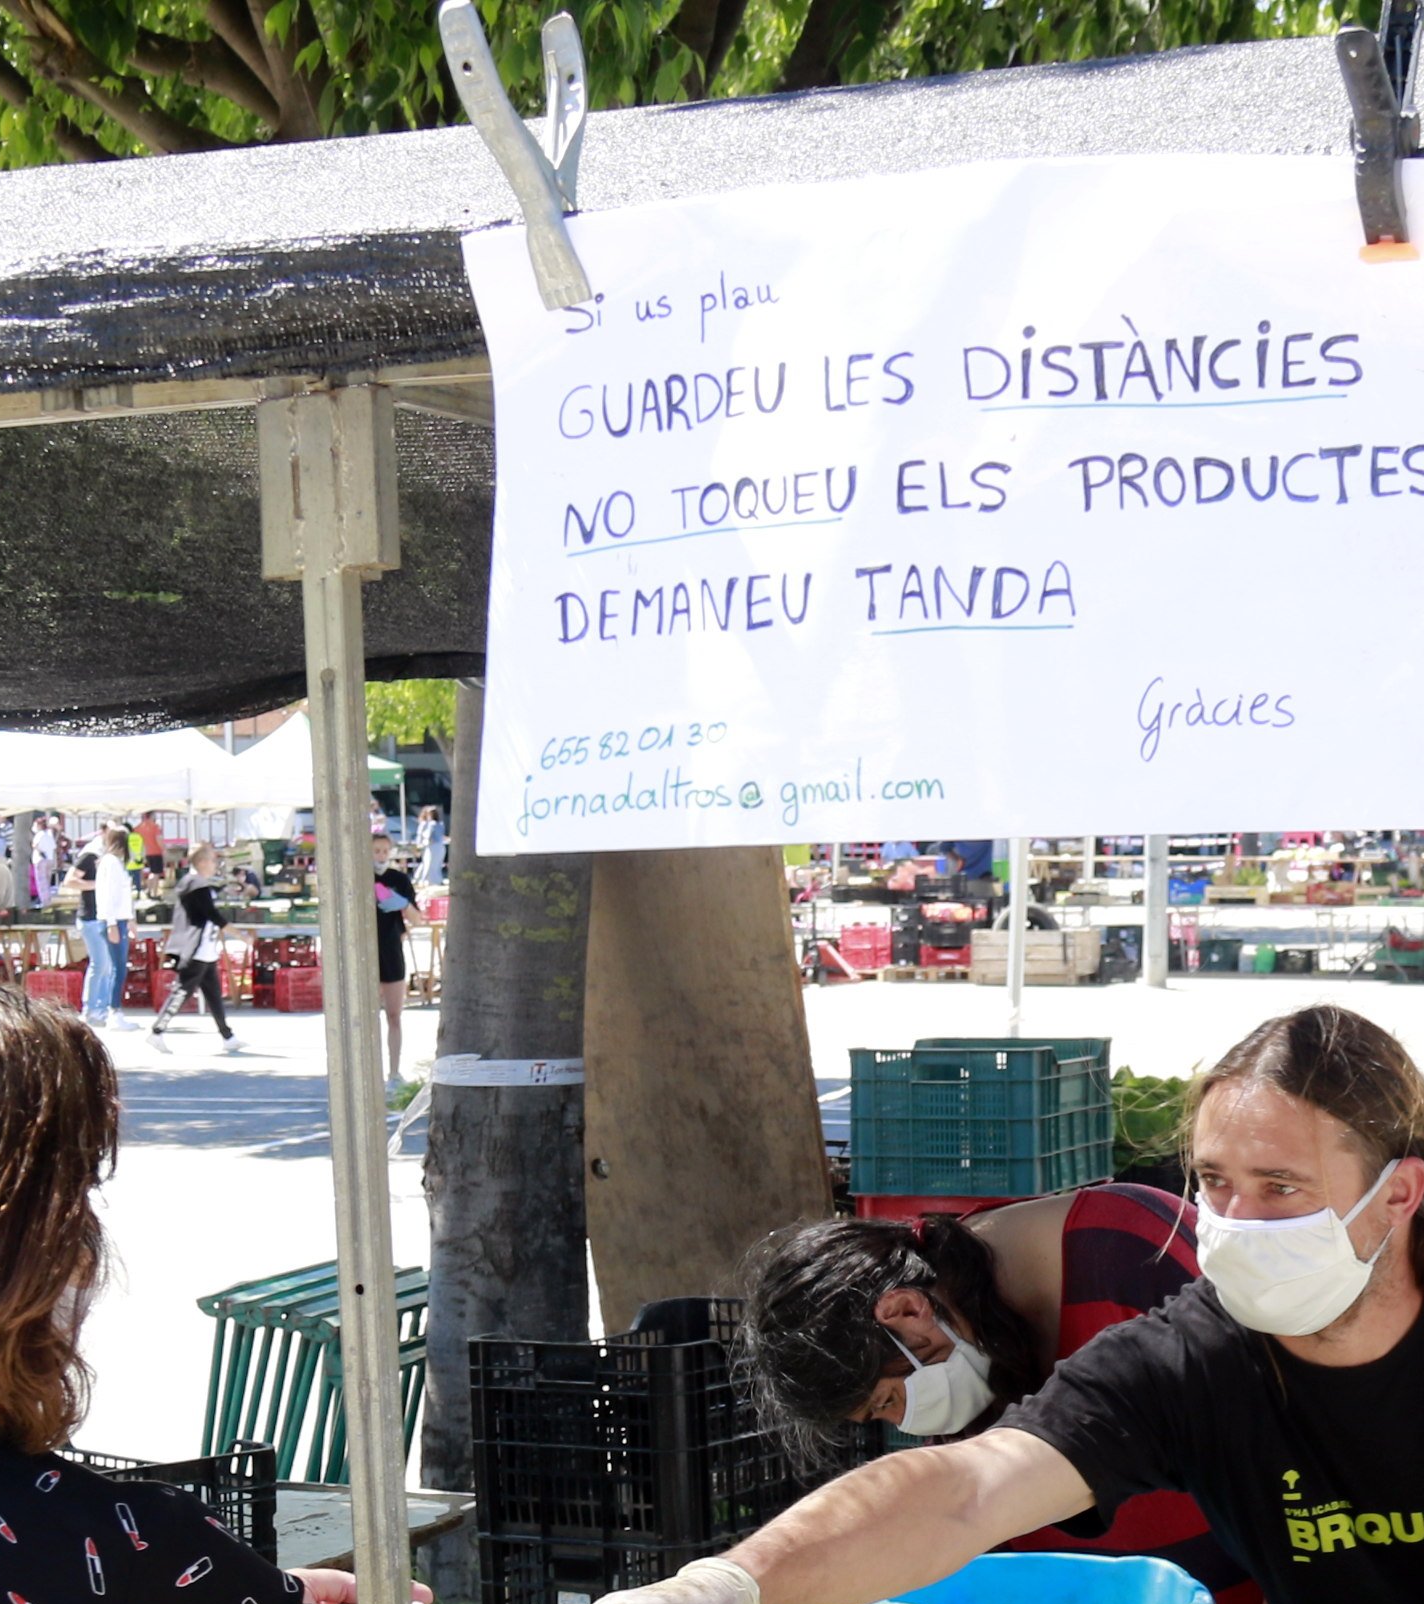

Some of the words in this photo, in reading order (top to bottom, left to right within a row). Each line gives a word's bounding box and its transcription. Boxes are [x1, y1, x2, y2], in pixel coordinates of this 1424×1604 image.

[562, 291, 605, 334] Si
[635, 294, 673, 322] us
[700, 270, 779, 343] plau
[558, 361, 787, 440] GUARDEU
[824, 350, 915, 412] LES
[564, 489, 637, 545] NO
[670, 464, 858, 530] TOQUEU
[895, 459, 1013, 516] ELS
[553, 572, 813, 645] DEMANEU
[854, 559, 1077, 622] TANDA
[1137, 676, 1296, 763] Gràcies
